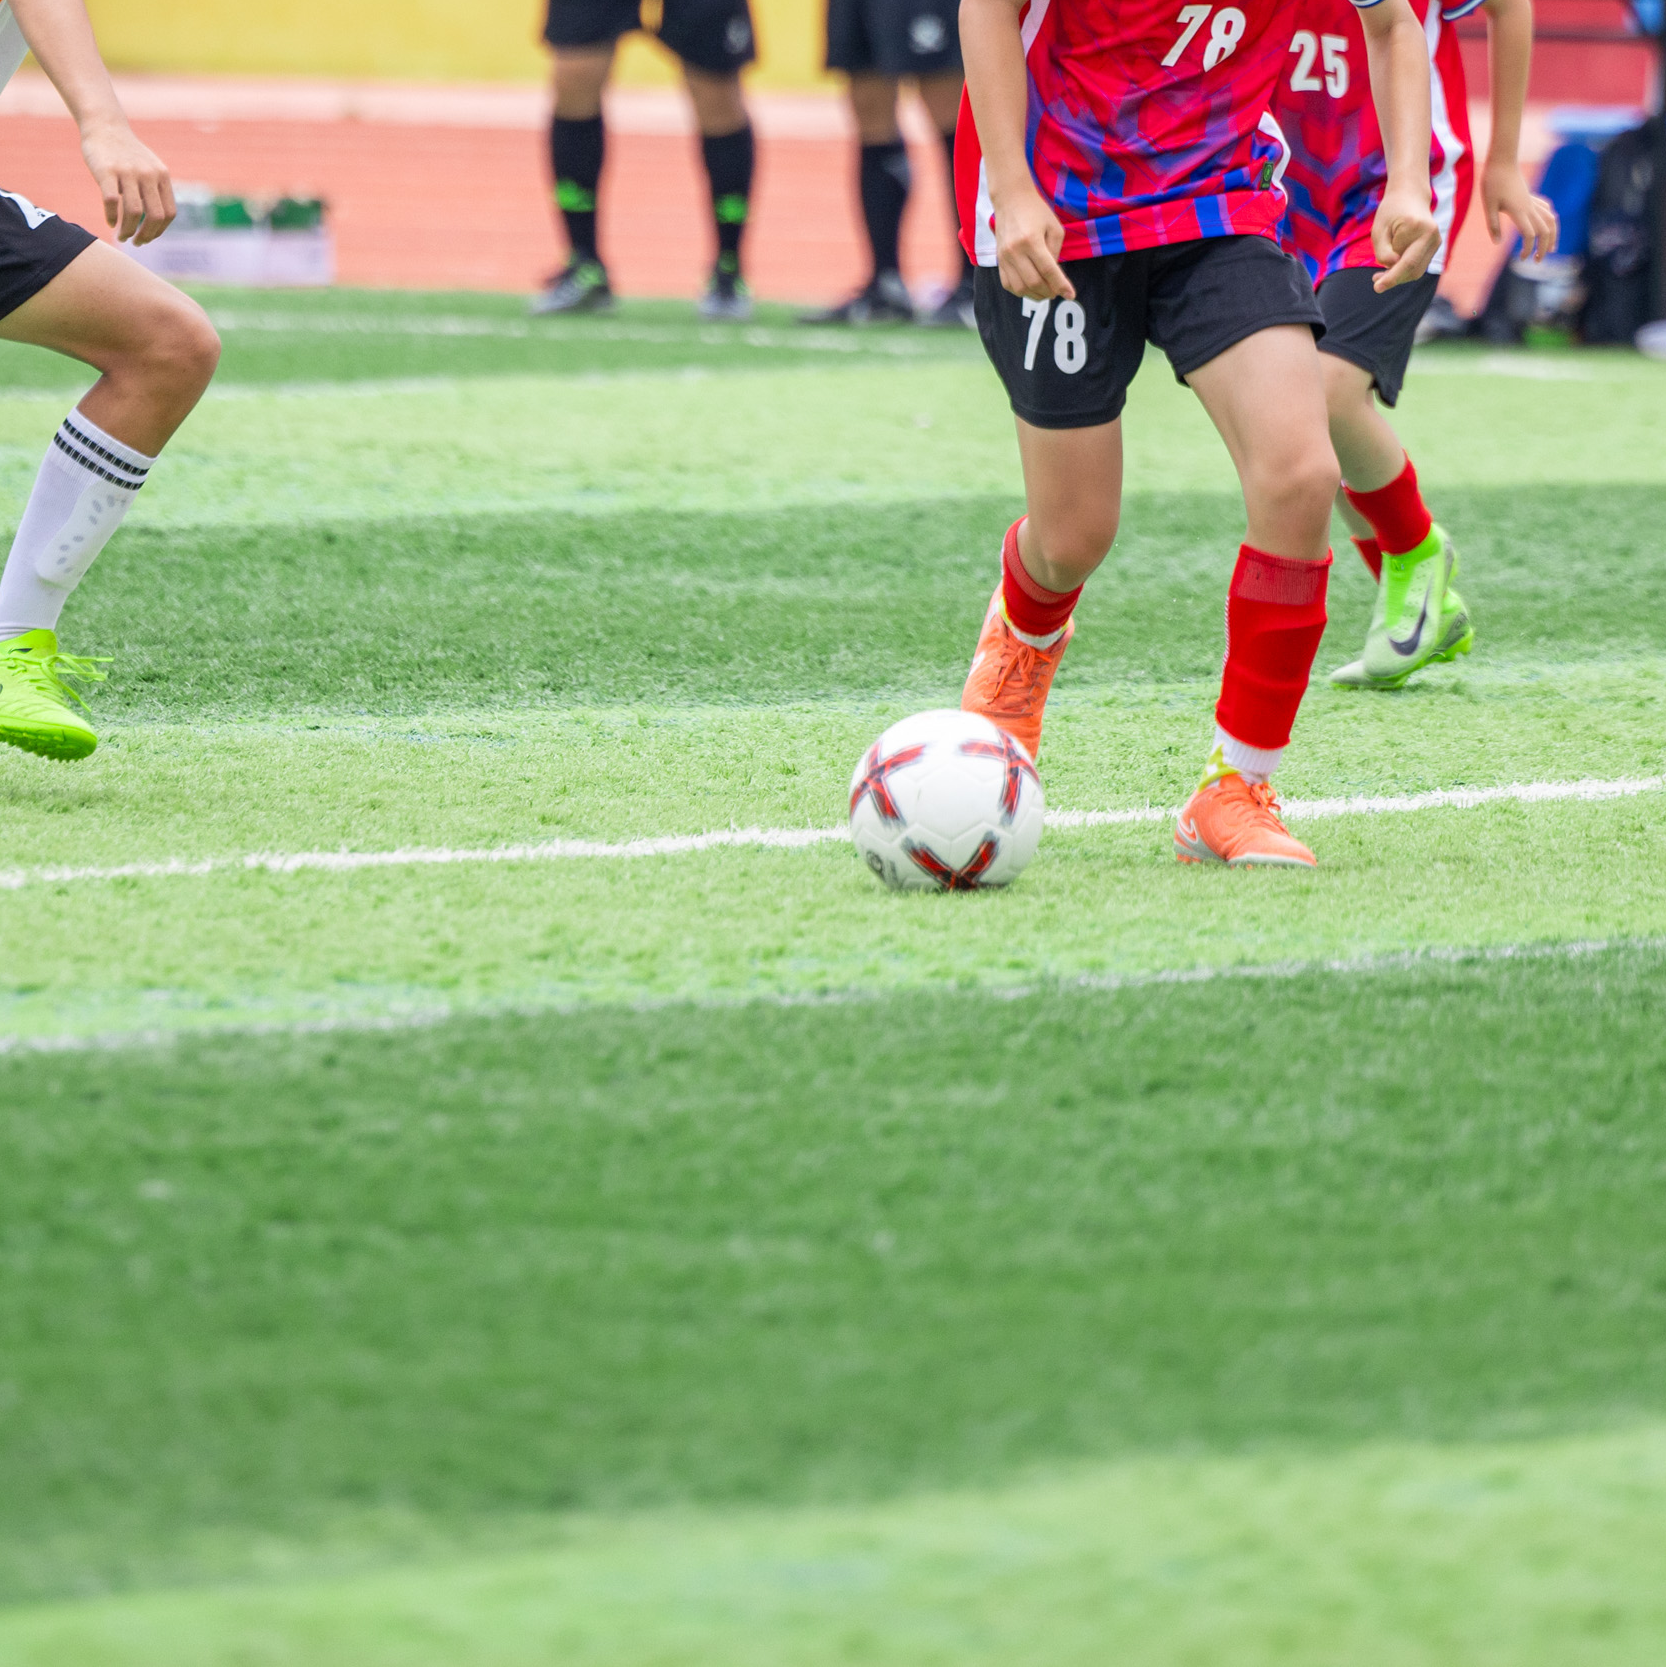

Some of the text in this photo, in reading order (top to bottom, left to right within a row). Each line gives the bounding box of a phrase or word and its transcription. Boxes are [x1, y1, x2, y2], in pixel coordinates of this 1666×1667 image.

[1160, 3, 1247, 73] 78
[1288, 29, 1350, 99] 25
[1021, 295, 1089, 375] 78
